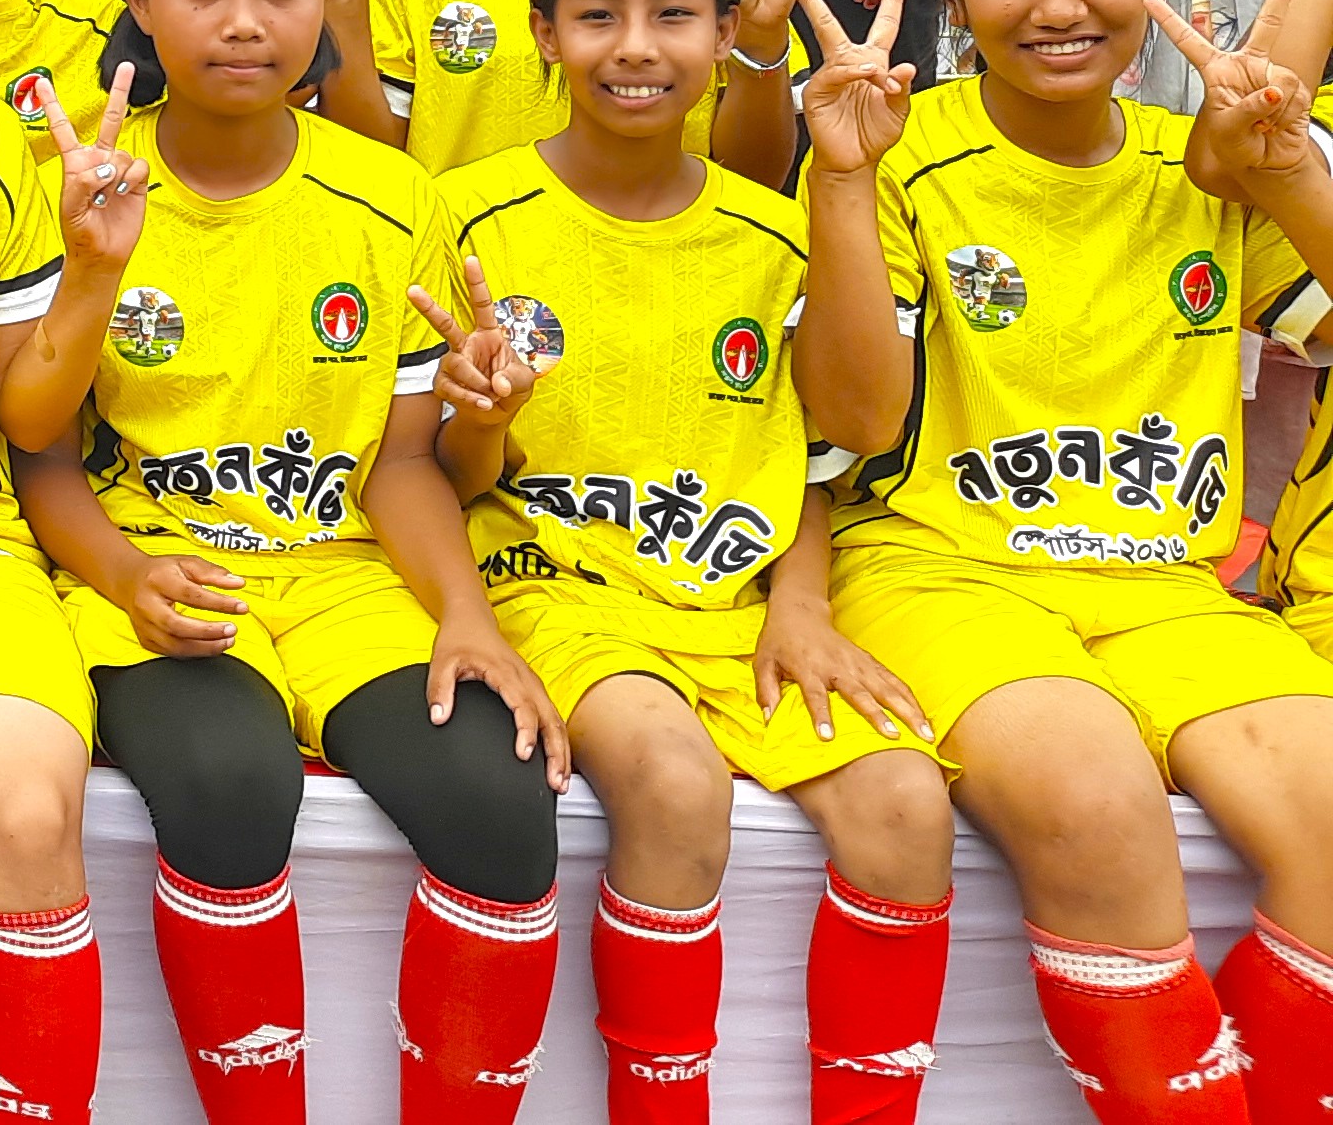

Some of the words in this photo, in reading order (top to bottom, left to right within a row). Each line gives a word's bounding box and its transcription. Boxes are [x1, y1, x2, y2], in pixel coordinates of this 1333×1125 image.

[637, 472, 770, 582] কুঁড়ি
[950, 430, 1104, 509] নতুন
[1108, 413, 1229, 535] কুঁড়ি
